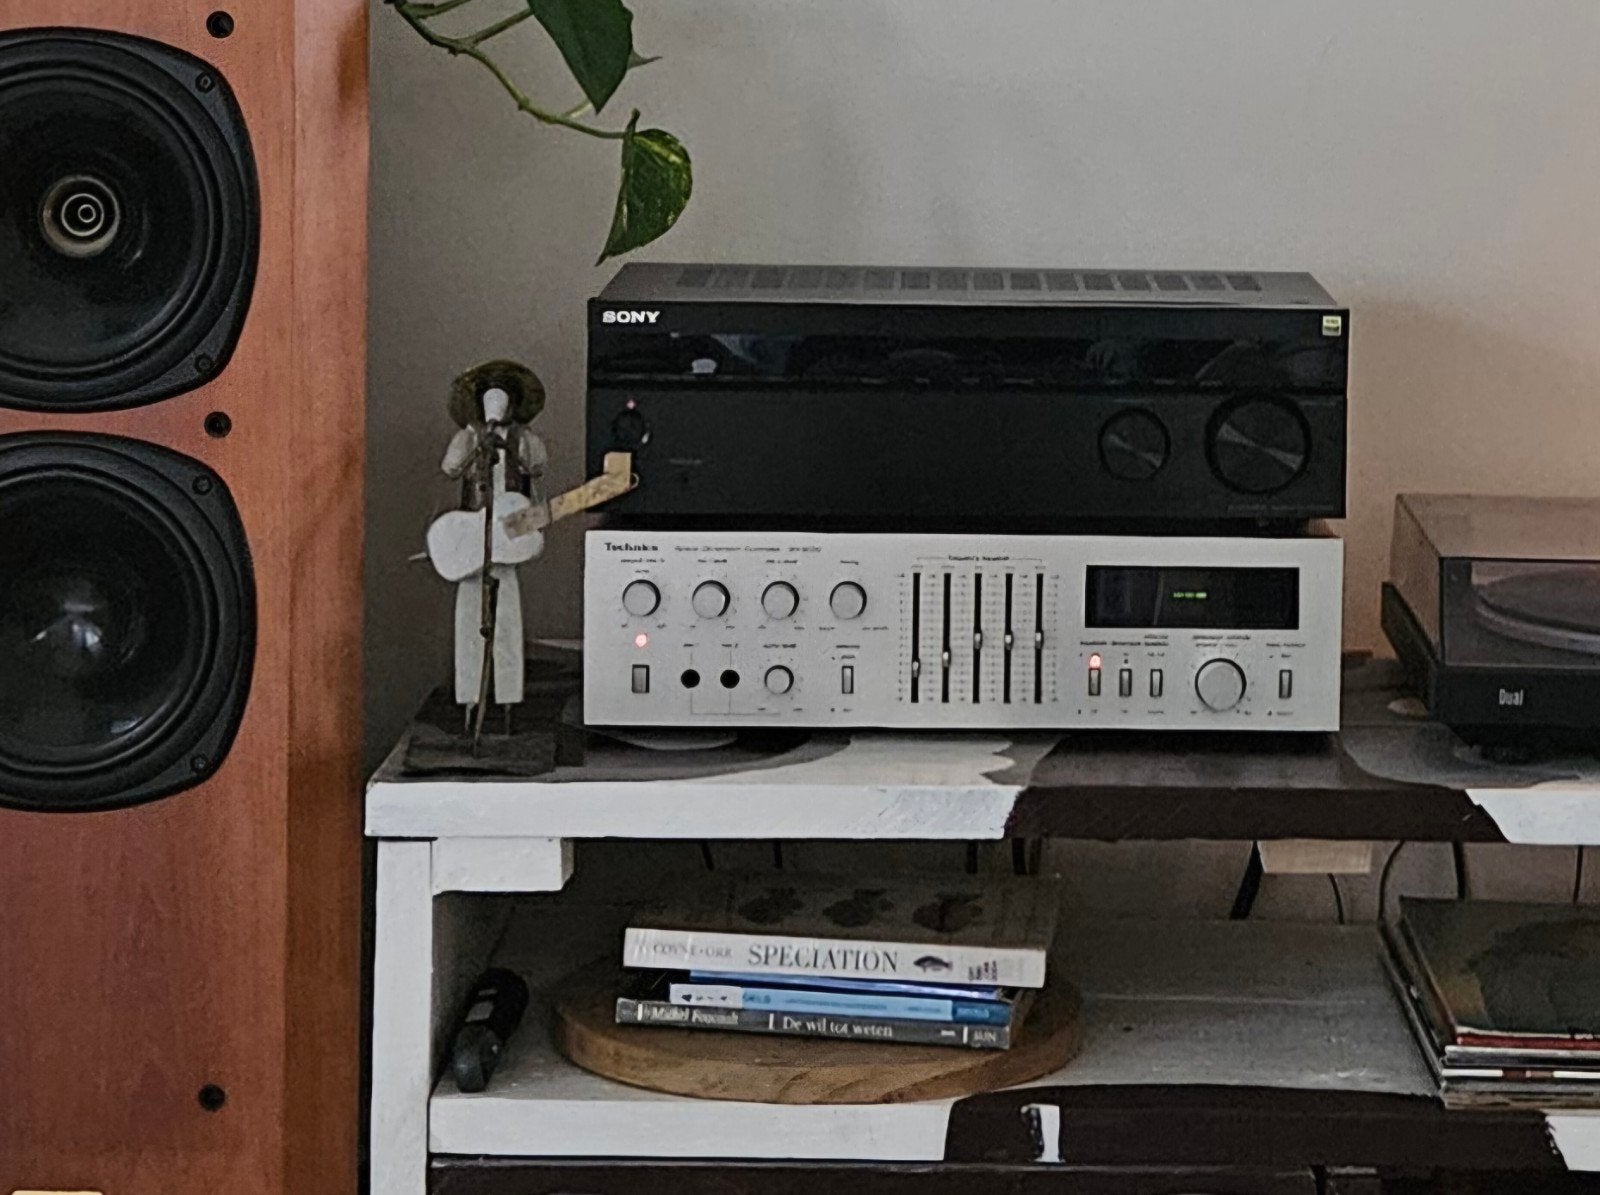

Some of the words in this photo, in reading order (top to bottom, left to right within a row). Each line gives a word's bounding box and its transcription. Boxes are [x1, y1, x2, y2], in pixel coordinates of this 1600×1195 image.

[602, 310, 661, 324] SONY
[1499, 688, 1524, 706] Dual
[747, 942, 898, 973] SPECIATION
